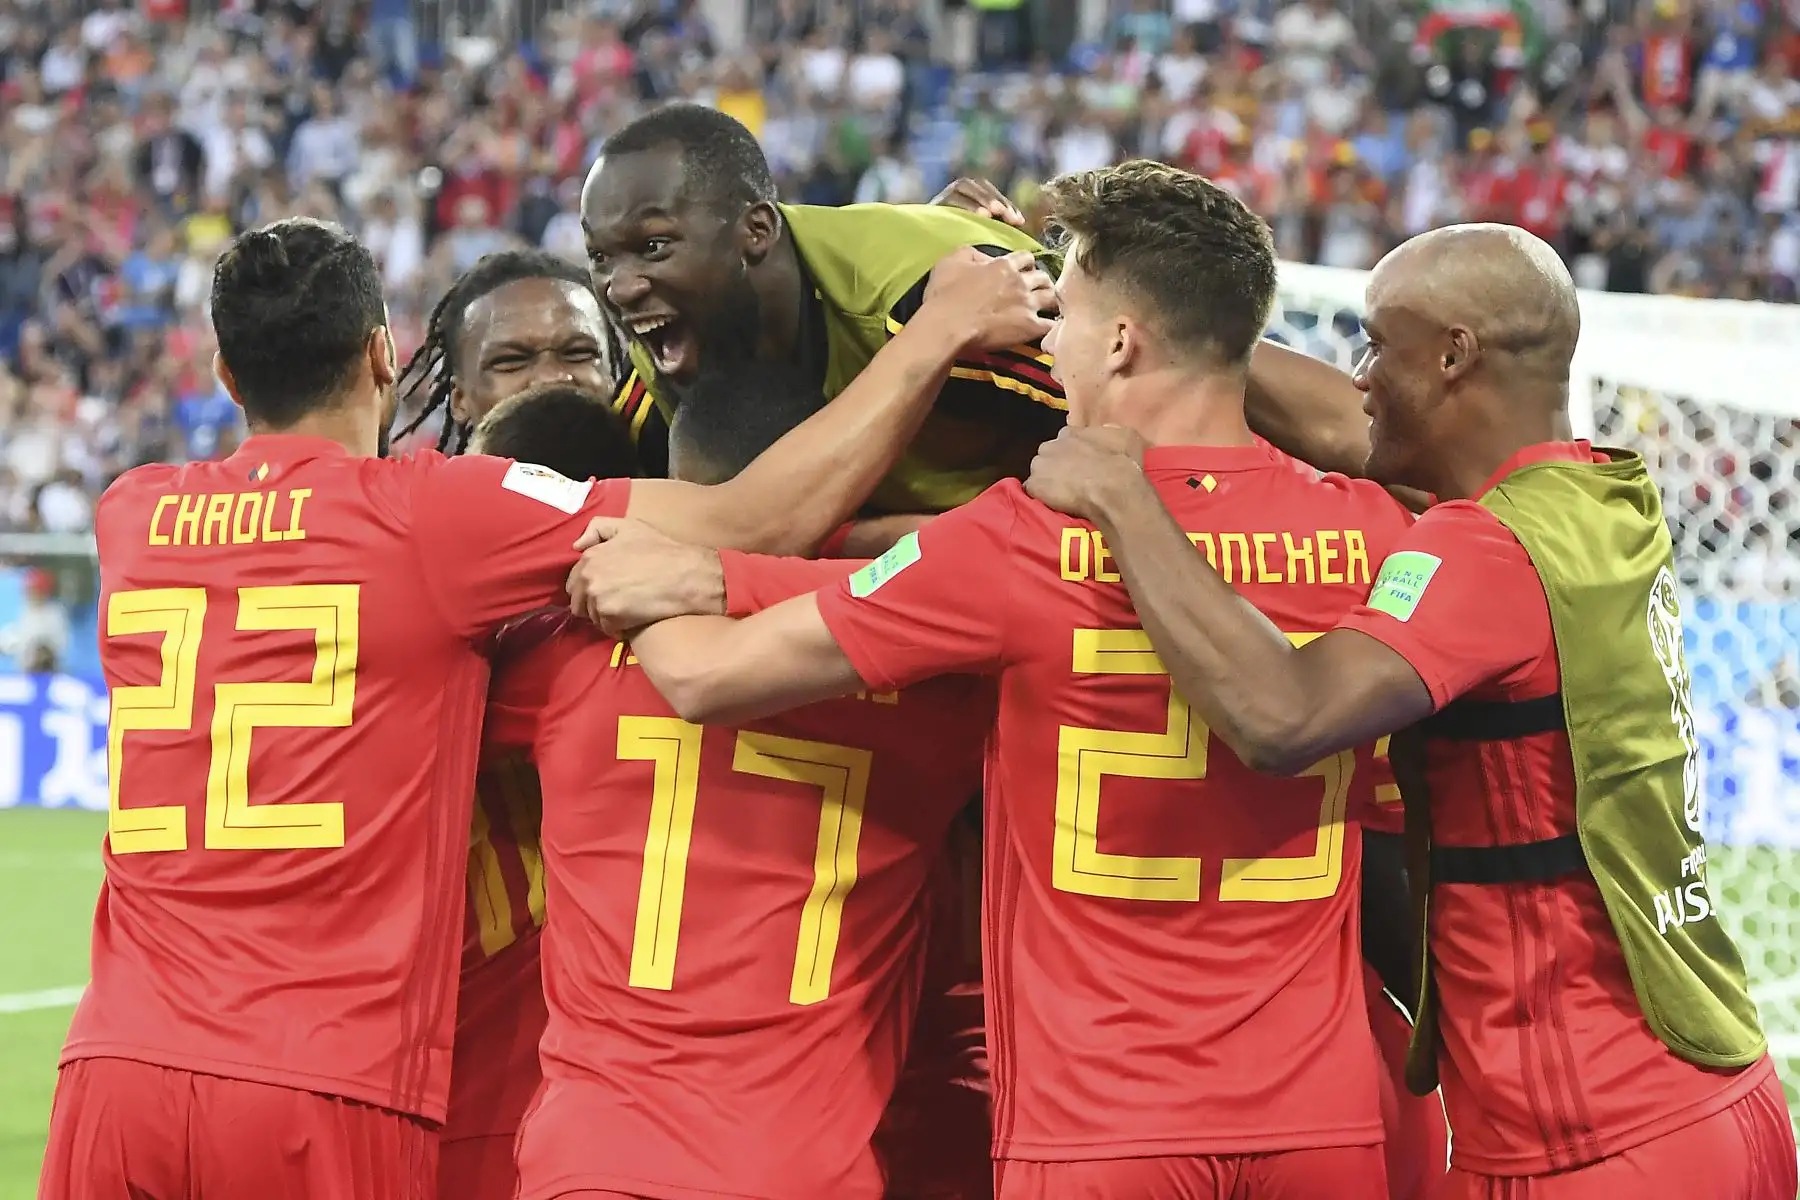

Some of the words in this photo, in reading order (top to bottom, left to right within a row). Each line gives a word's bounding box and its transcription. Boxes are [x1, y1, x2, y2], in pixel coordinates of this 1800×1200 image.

[149, 488, 312, 545] CHADLI
[1390, 588, 1412, 602] FIFA
[106, 584, 360, 855] 22
[616, 715, 873, 1006] 17
